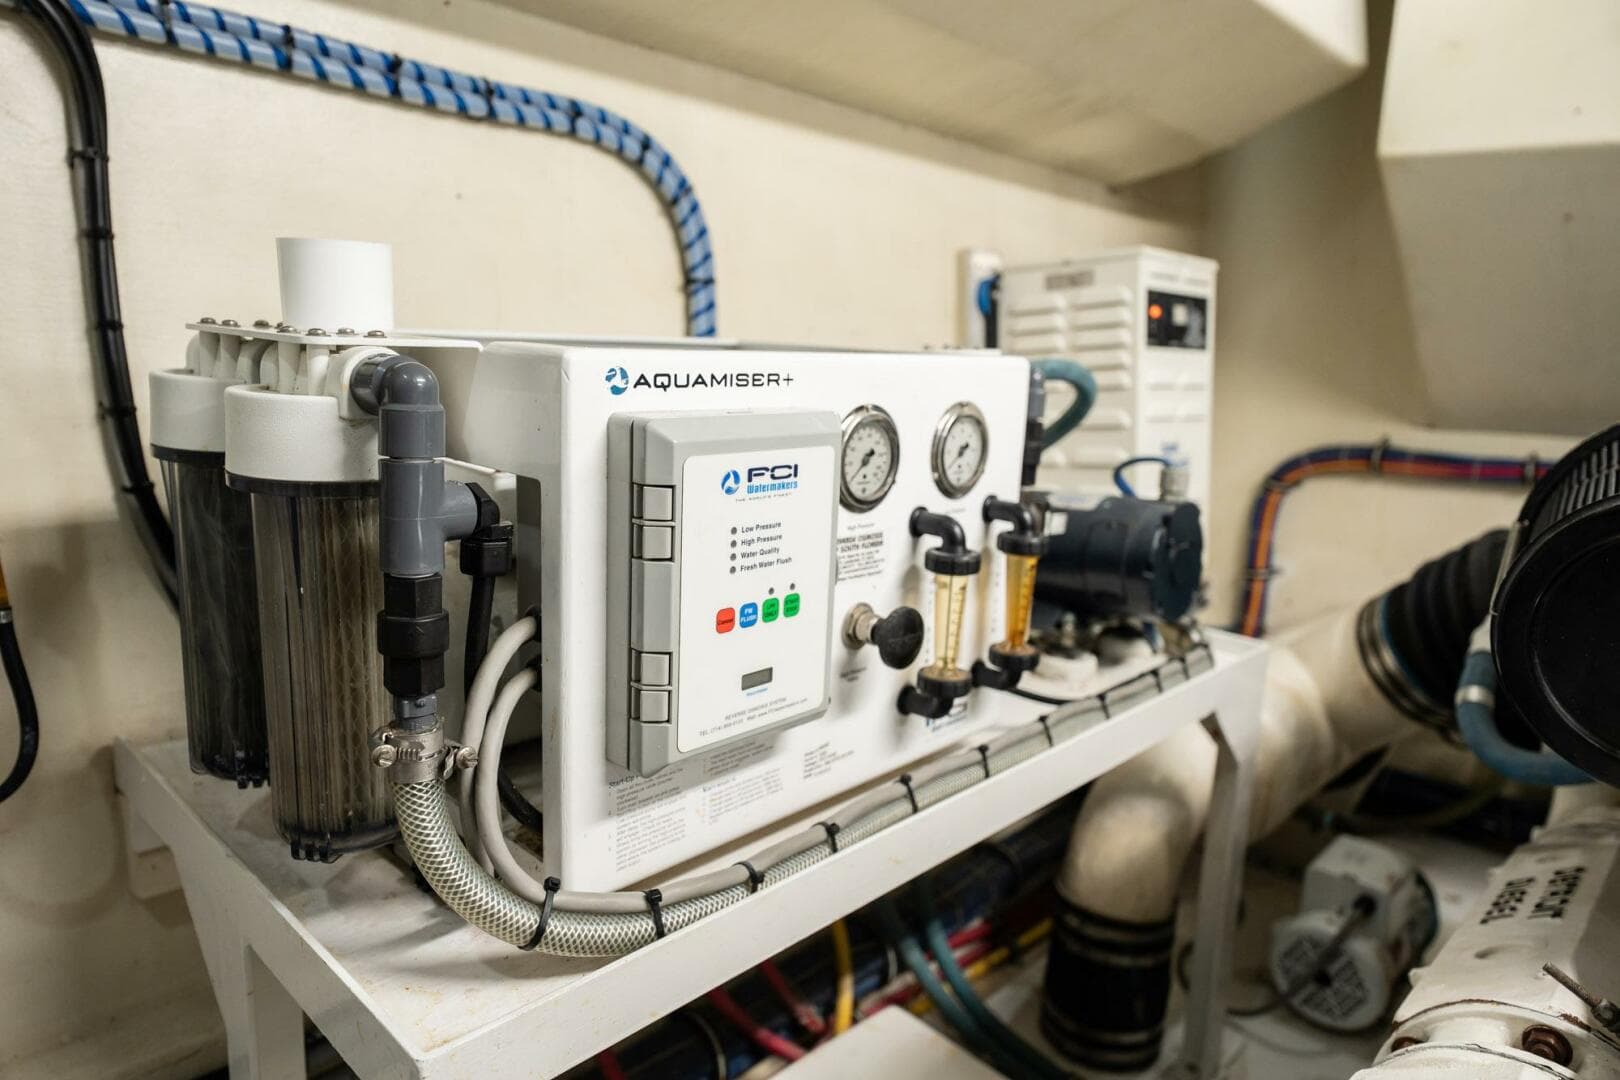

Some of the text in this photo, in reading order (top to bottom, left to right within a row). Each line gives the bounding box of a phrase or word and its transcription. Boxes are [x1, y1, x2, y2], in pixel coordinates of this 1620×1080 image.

[633, 372, 794, 391] AQUAMISER+
[748, 464, 798, 482] FCI
[747, 481, 798, 494] Watermakers
[741, 521, 781, 534] Low Pressure
[741, 534, 782, 547] High Pressure
[740, 547, 780, 559] Water Quality
[740, 557, 792, 572] Fresh Water Flush
